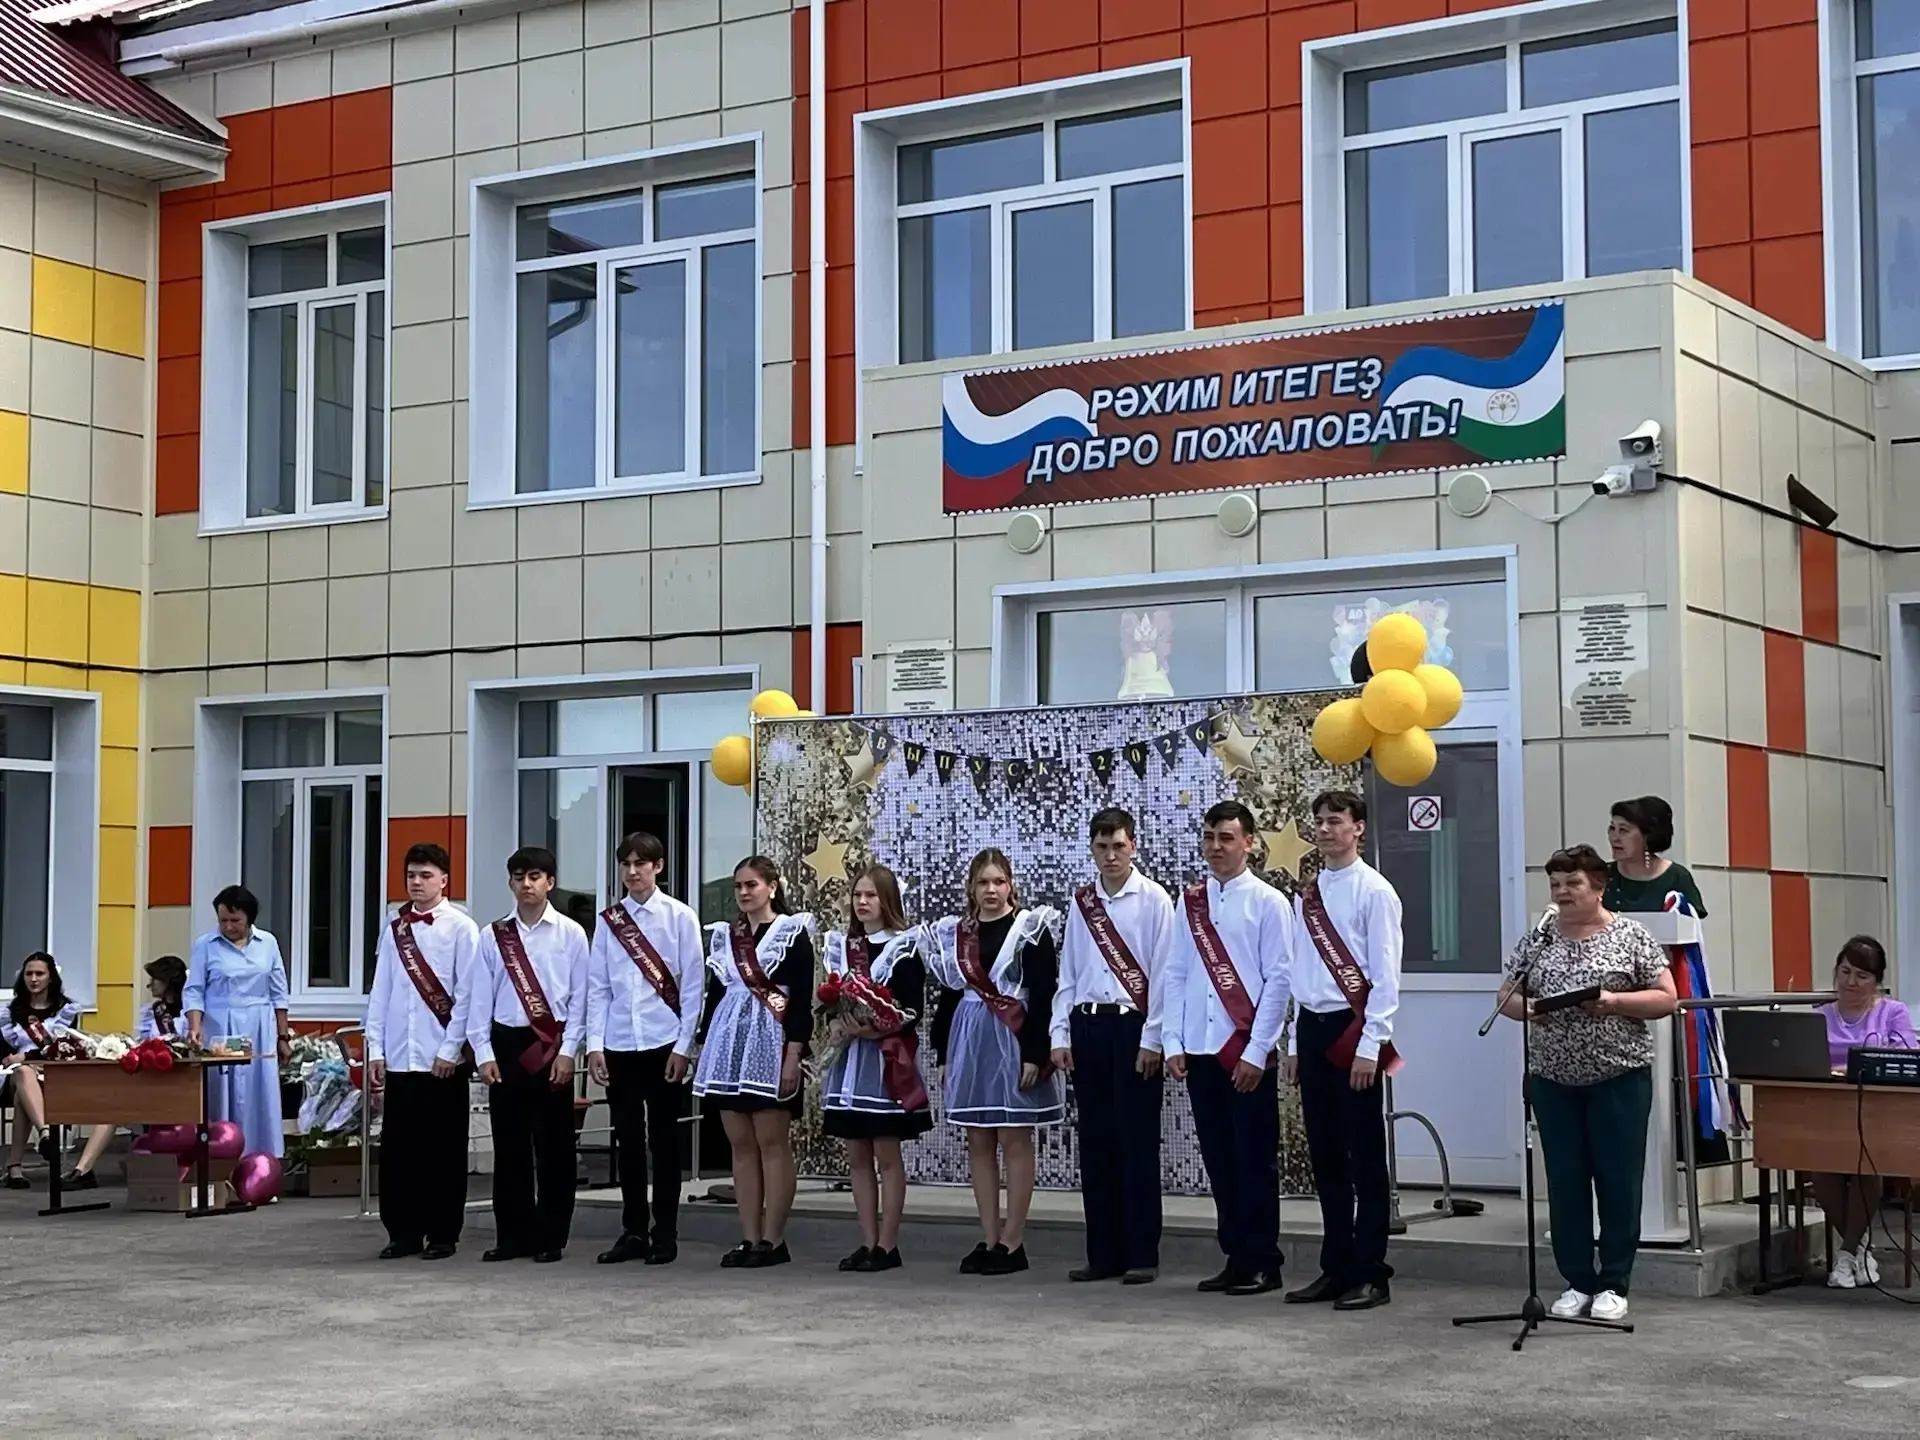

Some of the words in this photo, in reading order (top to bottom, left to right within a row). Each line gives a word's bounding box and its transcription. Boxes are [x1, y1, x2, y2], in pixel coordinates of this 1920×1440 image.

[1089, 374, 1222, 422] РӘХИМ
[1230, 357, 1383, 407] ИТЕГЕҘ
[1025, 432, 1160, 485] ДОБРО
[1173, 401, 1463, 463] ПОЖАЛОВАТЬ!
[876, 735, 1050, 777] ВЫПУСК
[1095, 725, 1206, 771] 2026
[1212, 963, 1240, 991] 2026
